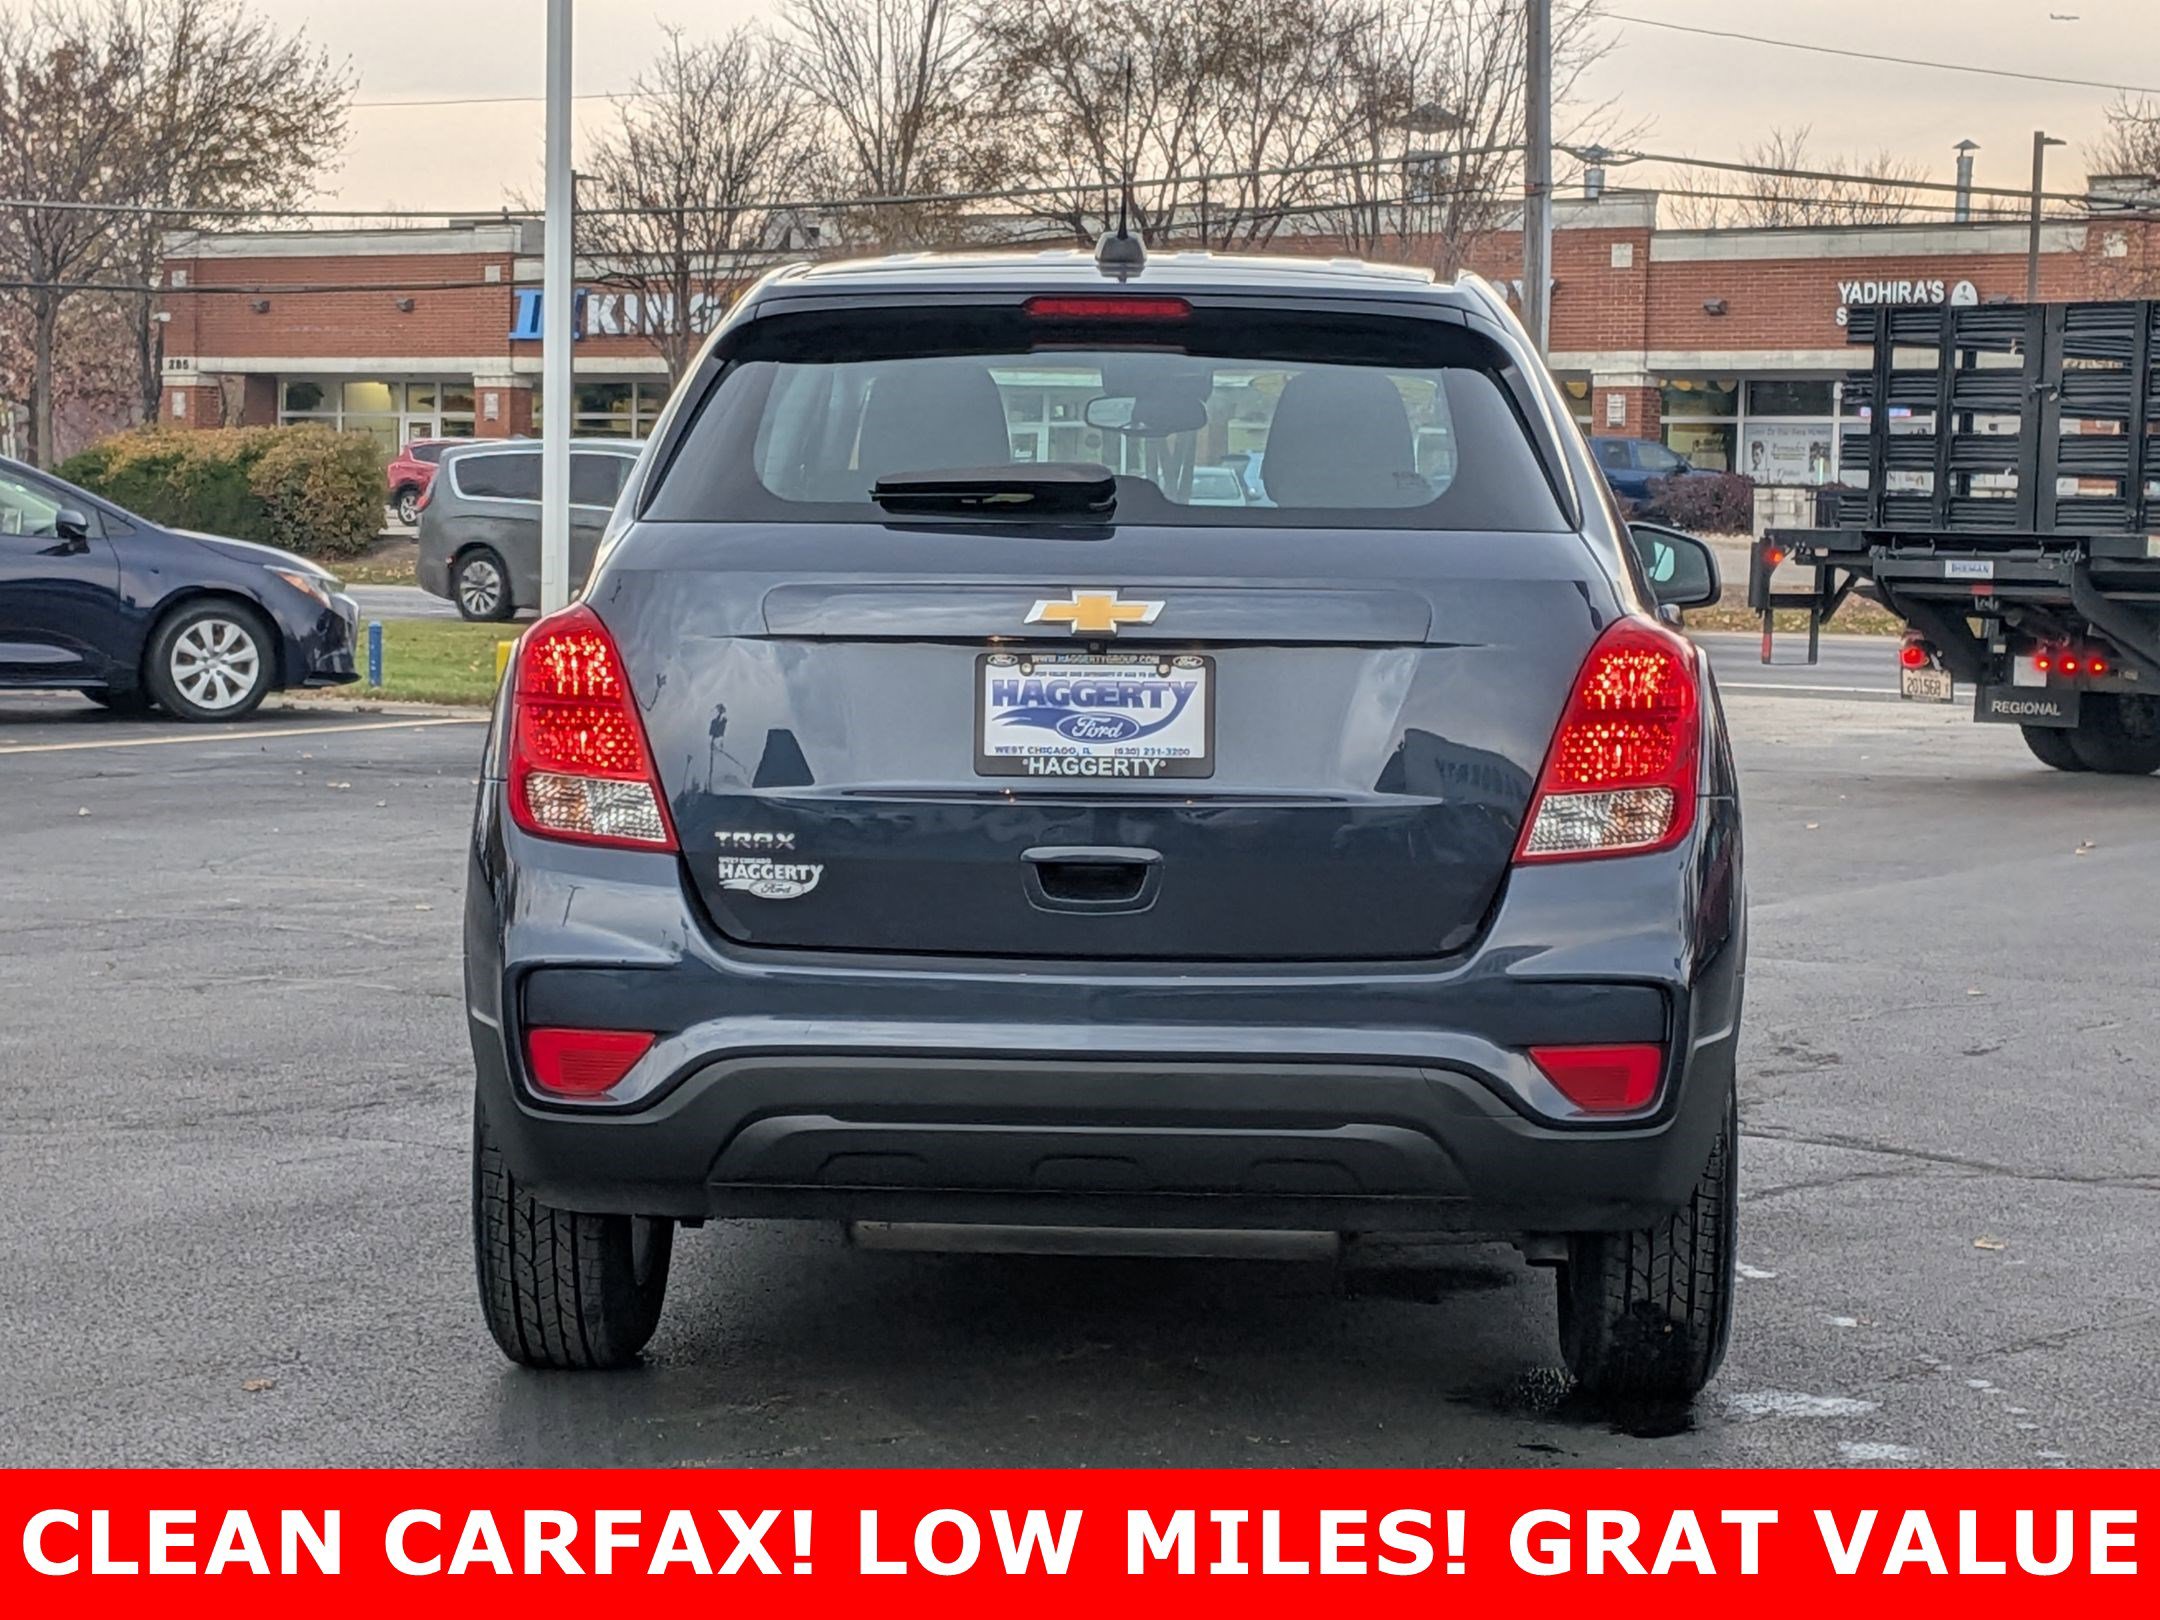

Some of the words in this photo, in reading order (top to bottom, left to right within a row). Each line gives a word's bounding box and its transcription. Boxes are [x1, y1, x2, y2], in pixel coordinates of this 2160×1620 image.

[1837, 280, 1944, 304] YADHIRA'S
[991, 679, 1198, 709] HAGGERTY
[1991, 700, 2062, 716] REGIONAL
[1071, 715, 1123, 739] Ford
[994, 746, 1024, 755] WEST
[1027, 757, 1160, 776] HAGGERTY
[714, 831, 796, 850] TRAX
[718, 864, 824, 881] HAGGERTY
